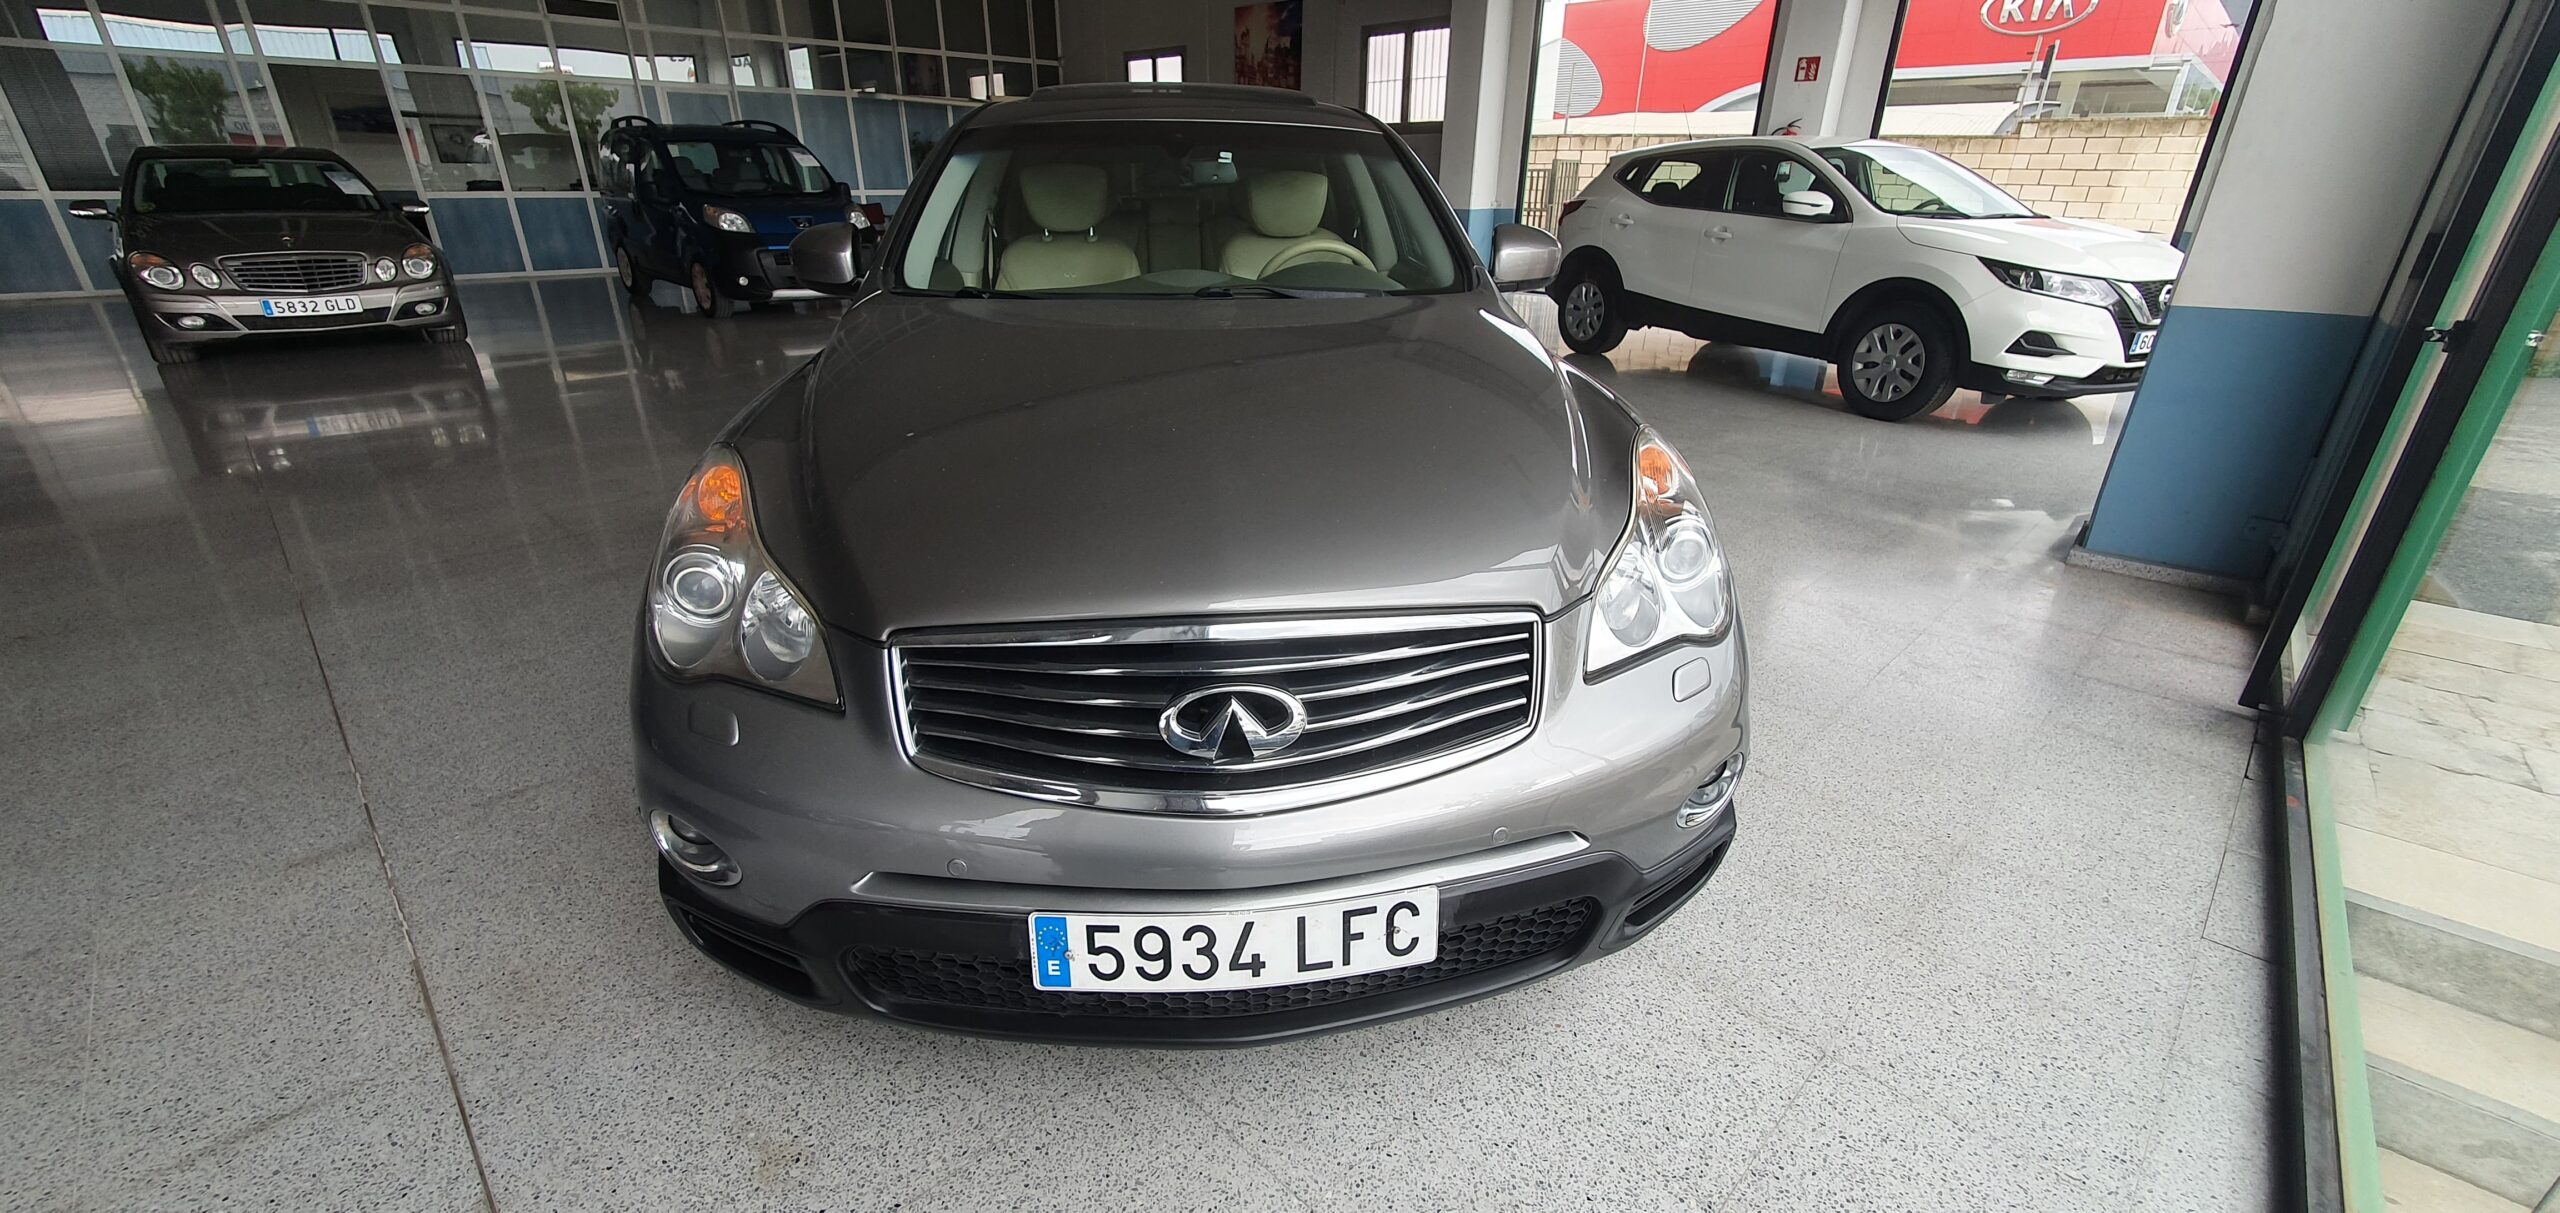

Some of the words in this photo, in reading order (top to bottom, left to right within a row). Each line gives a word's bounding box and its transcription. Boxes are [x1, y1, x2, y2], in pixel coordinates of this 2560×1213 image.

[1999, 0, 2074, 23] KIA
[274, 300, 320, 314] 5832
[324, 298, 356, 312] GLD
[1047, 960, 1061, 976] E
[1085, 921, 1266, 982] 5934
[1297, 901, 1420, 973] LFC
